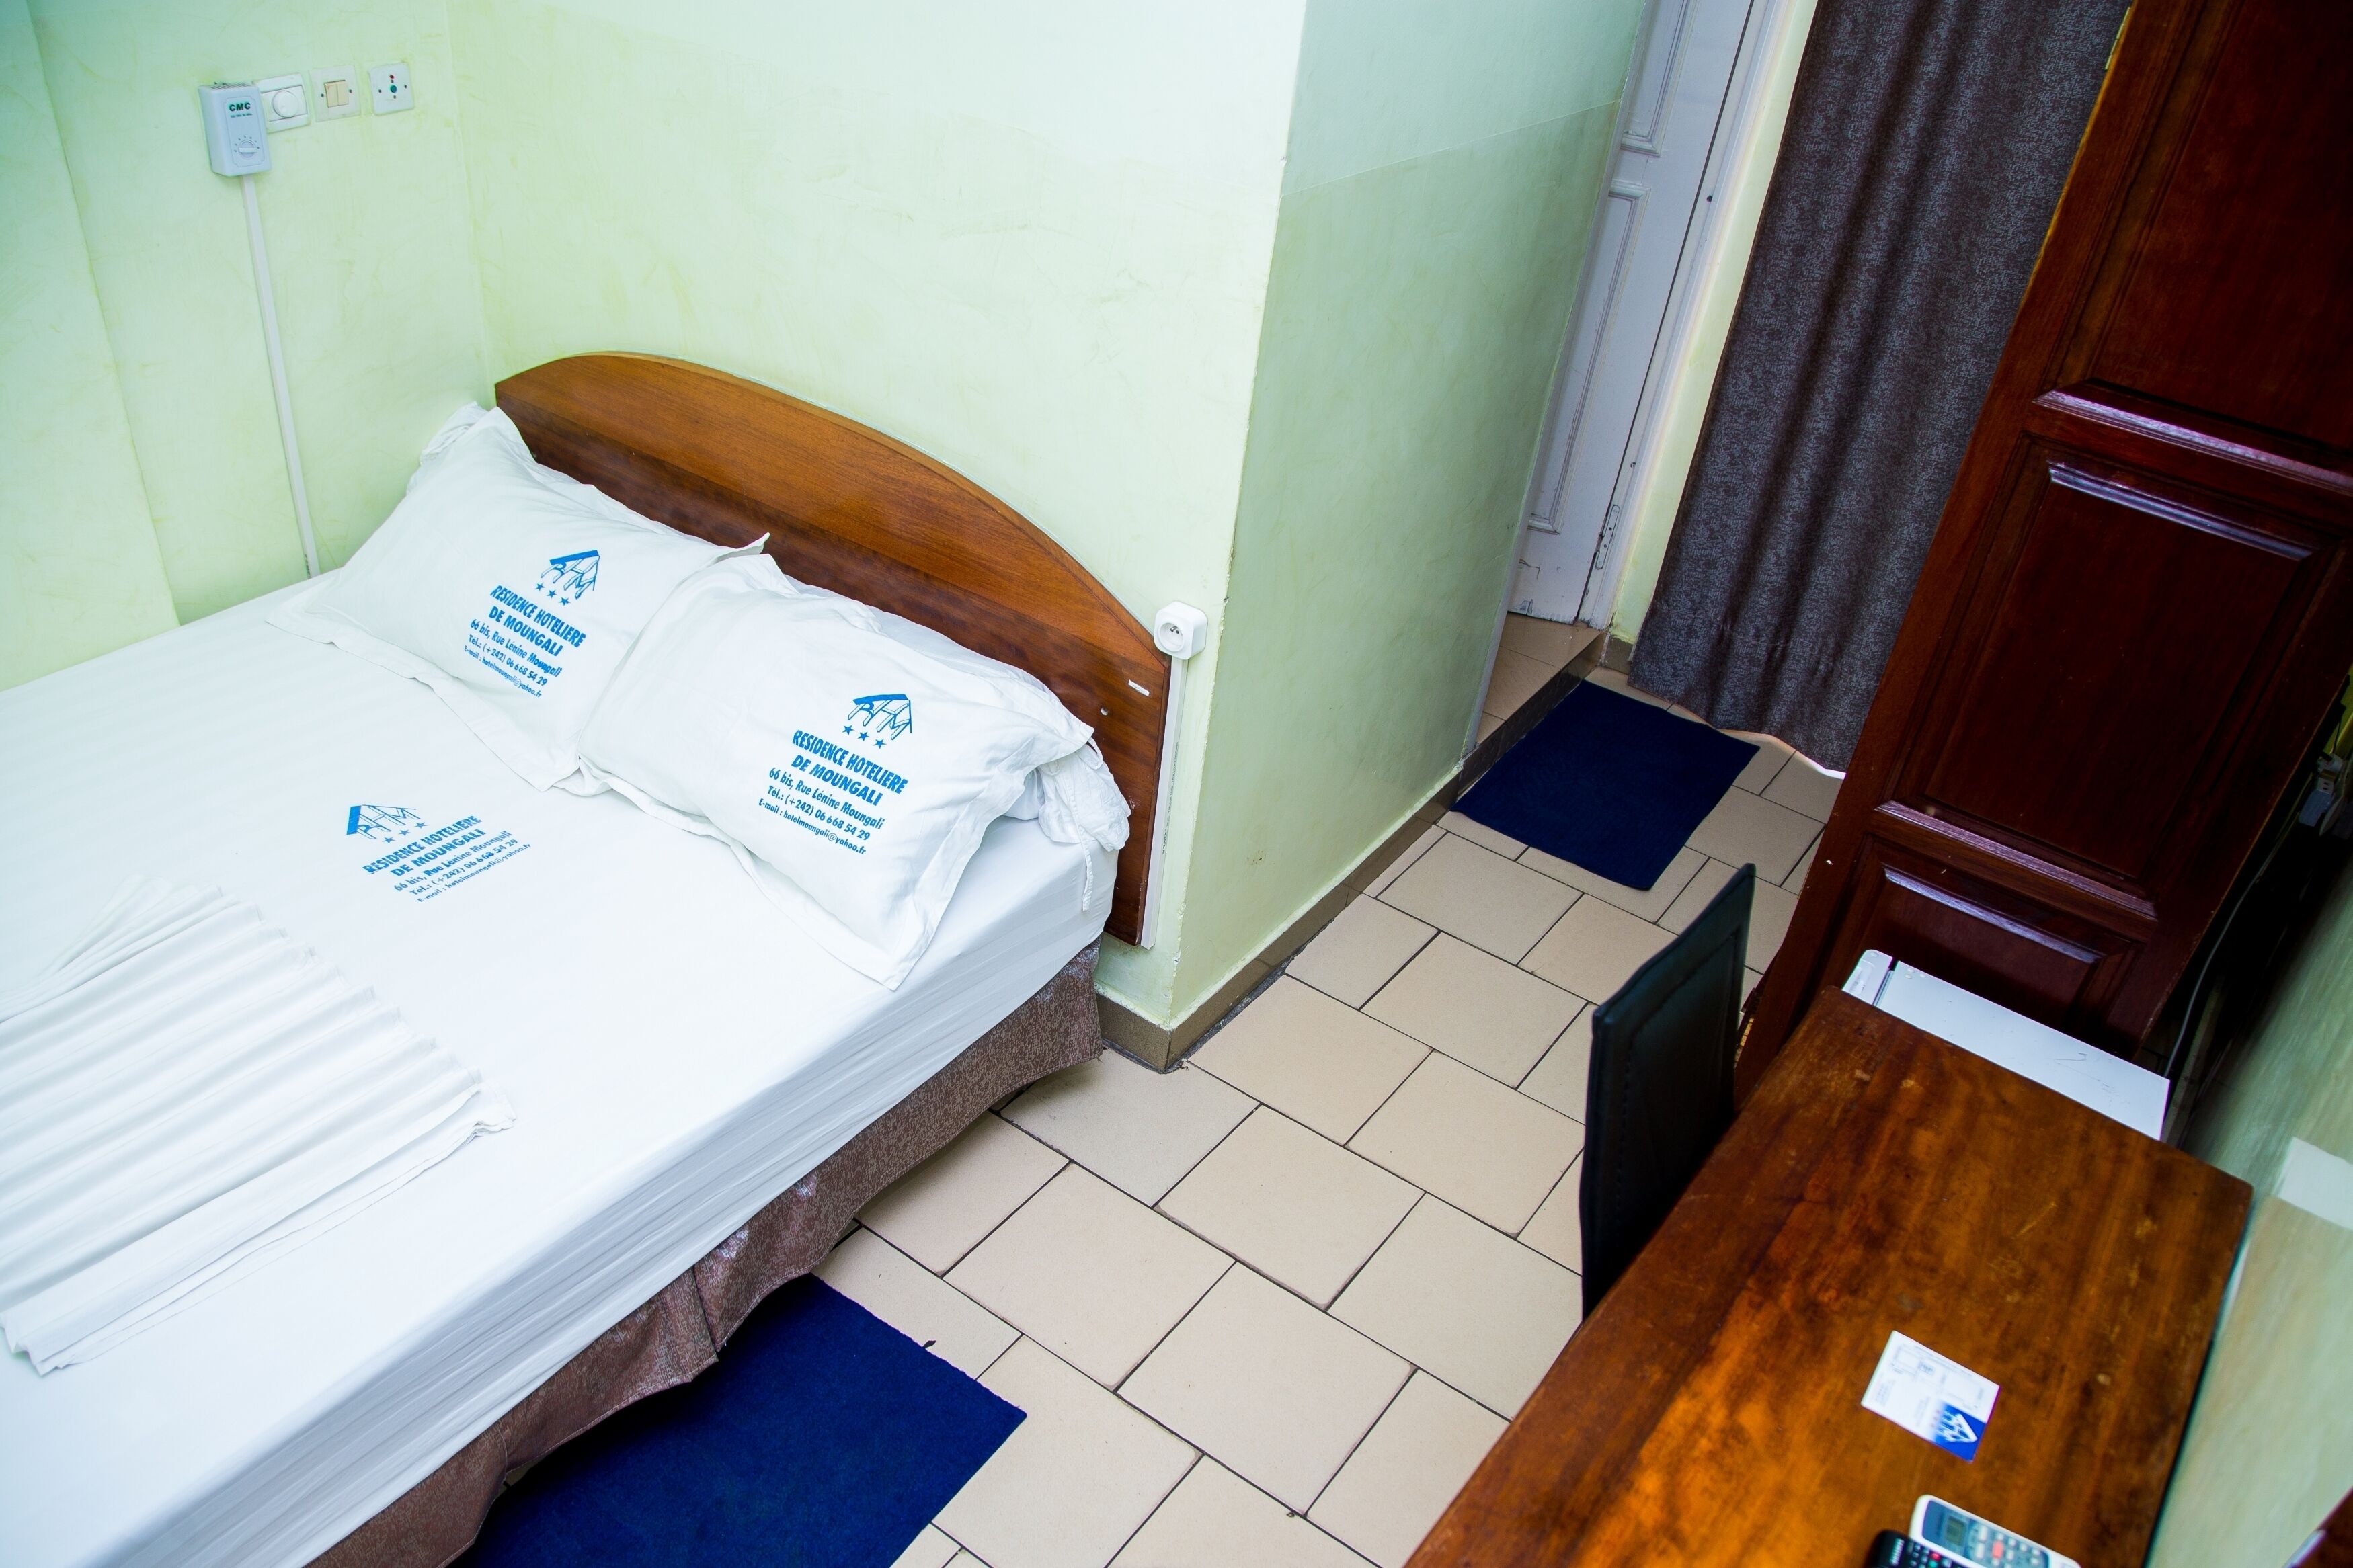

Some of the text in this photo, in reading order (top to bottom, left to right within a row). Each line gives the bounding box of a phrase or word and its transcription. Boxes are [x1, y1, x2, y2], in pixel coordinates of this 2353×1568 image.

[229, 102, 251, 112] CMC
[489, 606, 563, 656] DE MOUNGALI
[490, 585, 586, 647] RESIDENCE HOTELIERE
[471, 619, 480, 630] 66
[492, 631, 505, 645] Rue
[527, 653, 562, 677] Moungali
[527, 671, 538, 681] 54
[536, 677, 547, 686] 29
[791, 755, 883, 806] DE MOUNGALI
[793, 730, 908, 794] RESIDENCE HOTELIERE
[769, 768, 885, 829] 66 bis, Rue Lénine Moungali
[815, 809, 826, 821] 06
[844, 823, 857, 835] 54
[857, 829, 870, 840] 29
[362, 816, 481, 874] RESIDENCE HOTELIERE
[390, 829, 485, 876] DE MOUNGALI
[493, 843, 506, 854] 54
[506, 839, 518, 847] 29
[759, 798, 780, 813] E-mail
[783, 810, 866, 854] hotelmoungali@yahoo.fr
[394, 882, 408, 891] 66
[423, 866, 444, 876] Rue
[471, 831, 512, 852] Moungali
